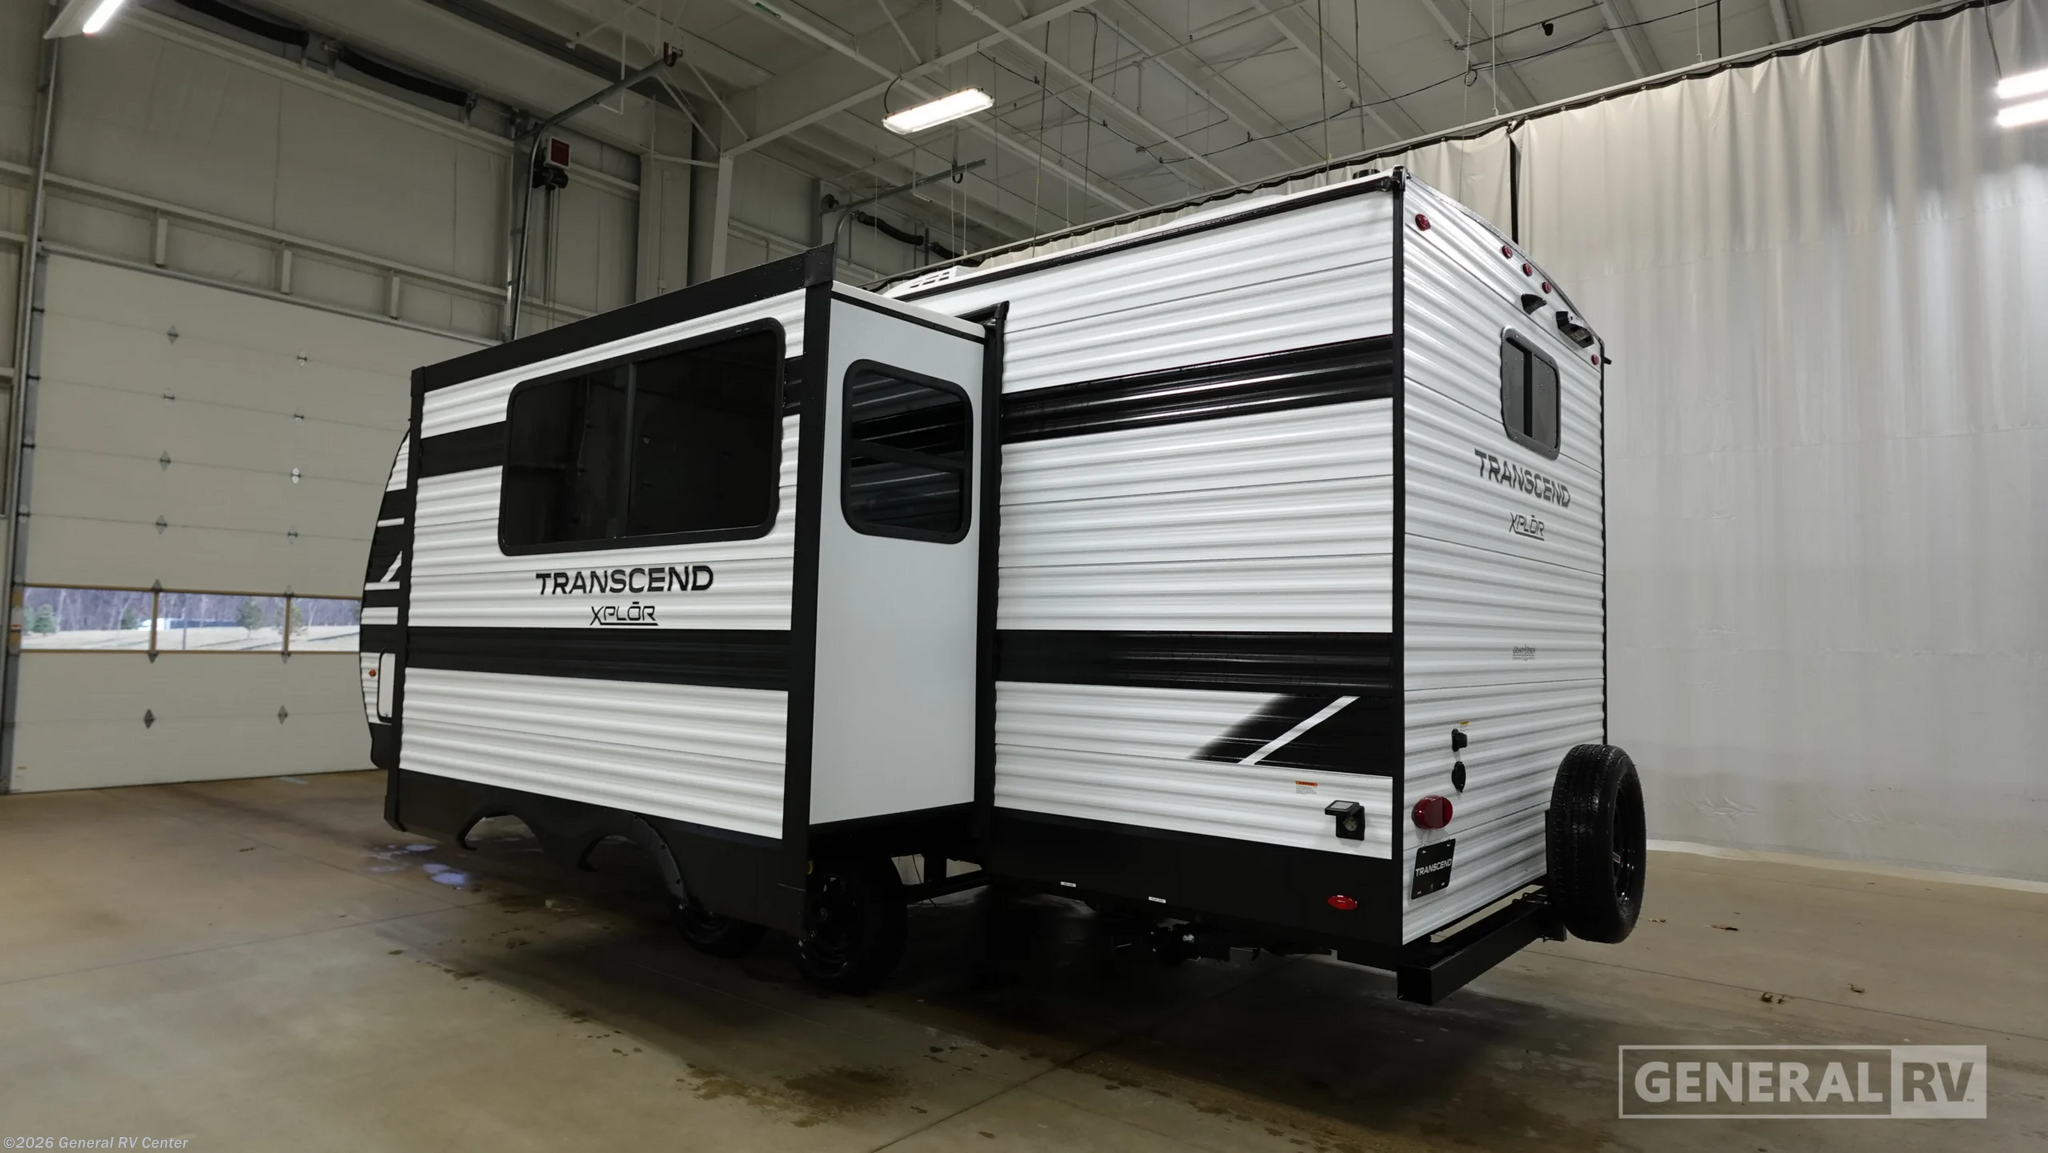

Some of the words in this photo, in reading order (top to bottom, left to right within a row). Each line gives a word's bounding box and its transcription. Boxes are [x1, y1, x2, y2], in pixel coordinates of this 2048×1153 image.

[1474, 448, 1571, 508] TRANSCEND
[535, 565, 714, 595] TRANSCEND
[1415, 858, 1453, 877] TRANSCEND
